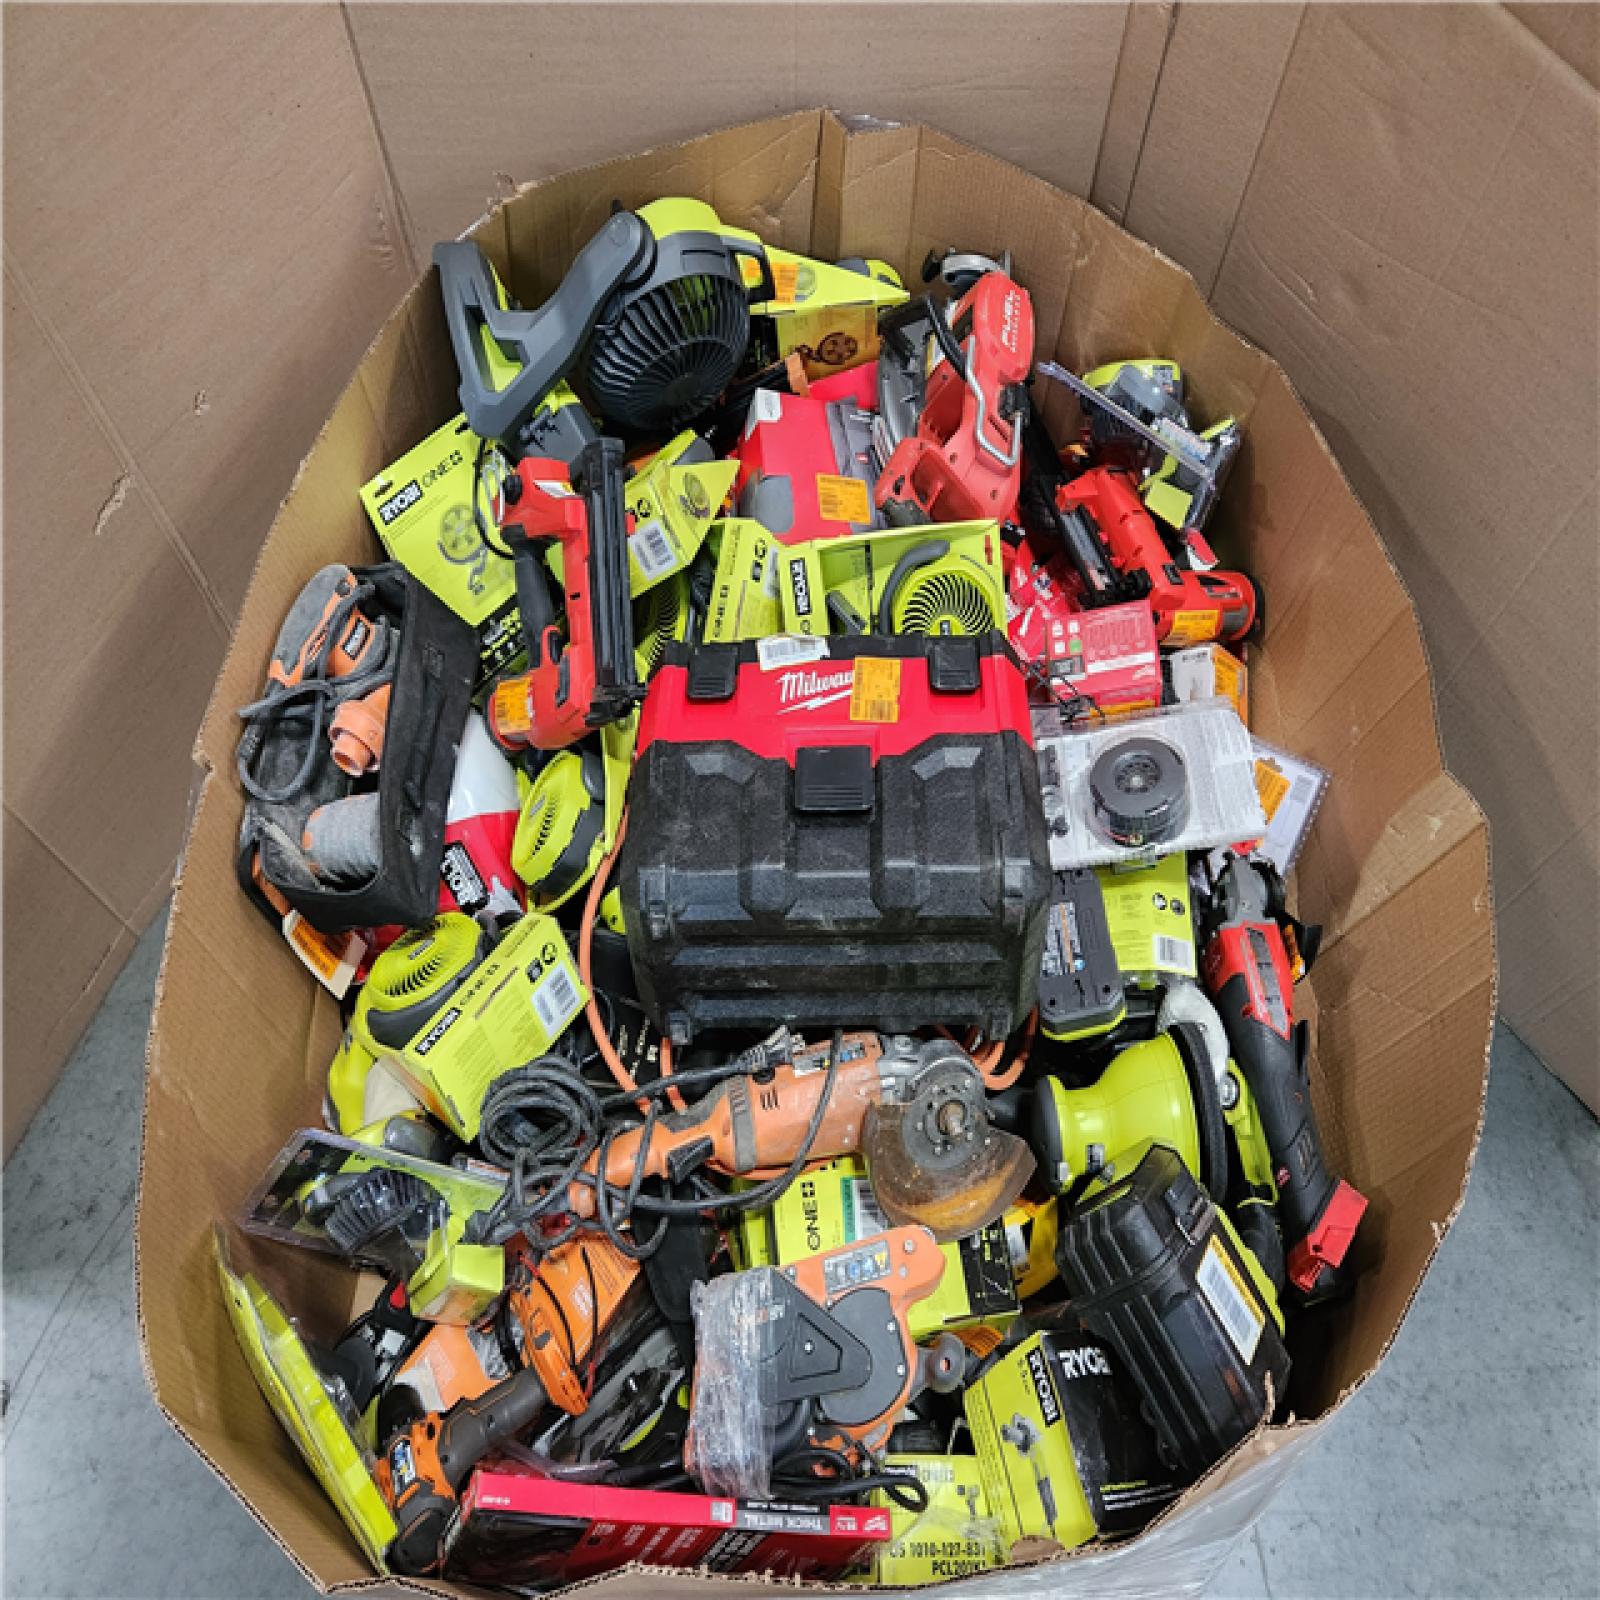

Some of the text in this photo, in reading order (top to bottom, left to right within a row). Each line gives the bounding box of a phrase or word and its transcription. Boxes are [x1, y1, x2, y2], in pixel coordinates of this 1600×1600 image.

[379, 482, 422, 522] RYOBI
[776, 669, 854, 703] Milwau
[1029, 1349, 1058, 1422] RYOBI
